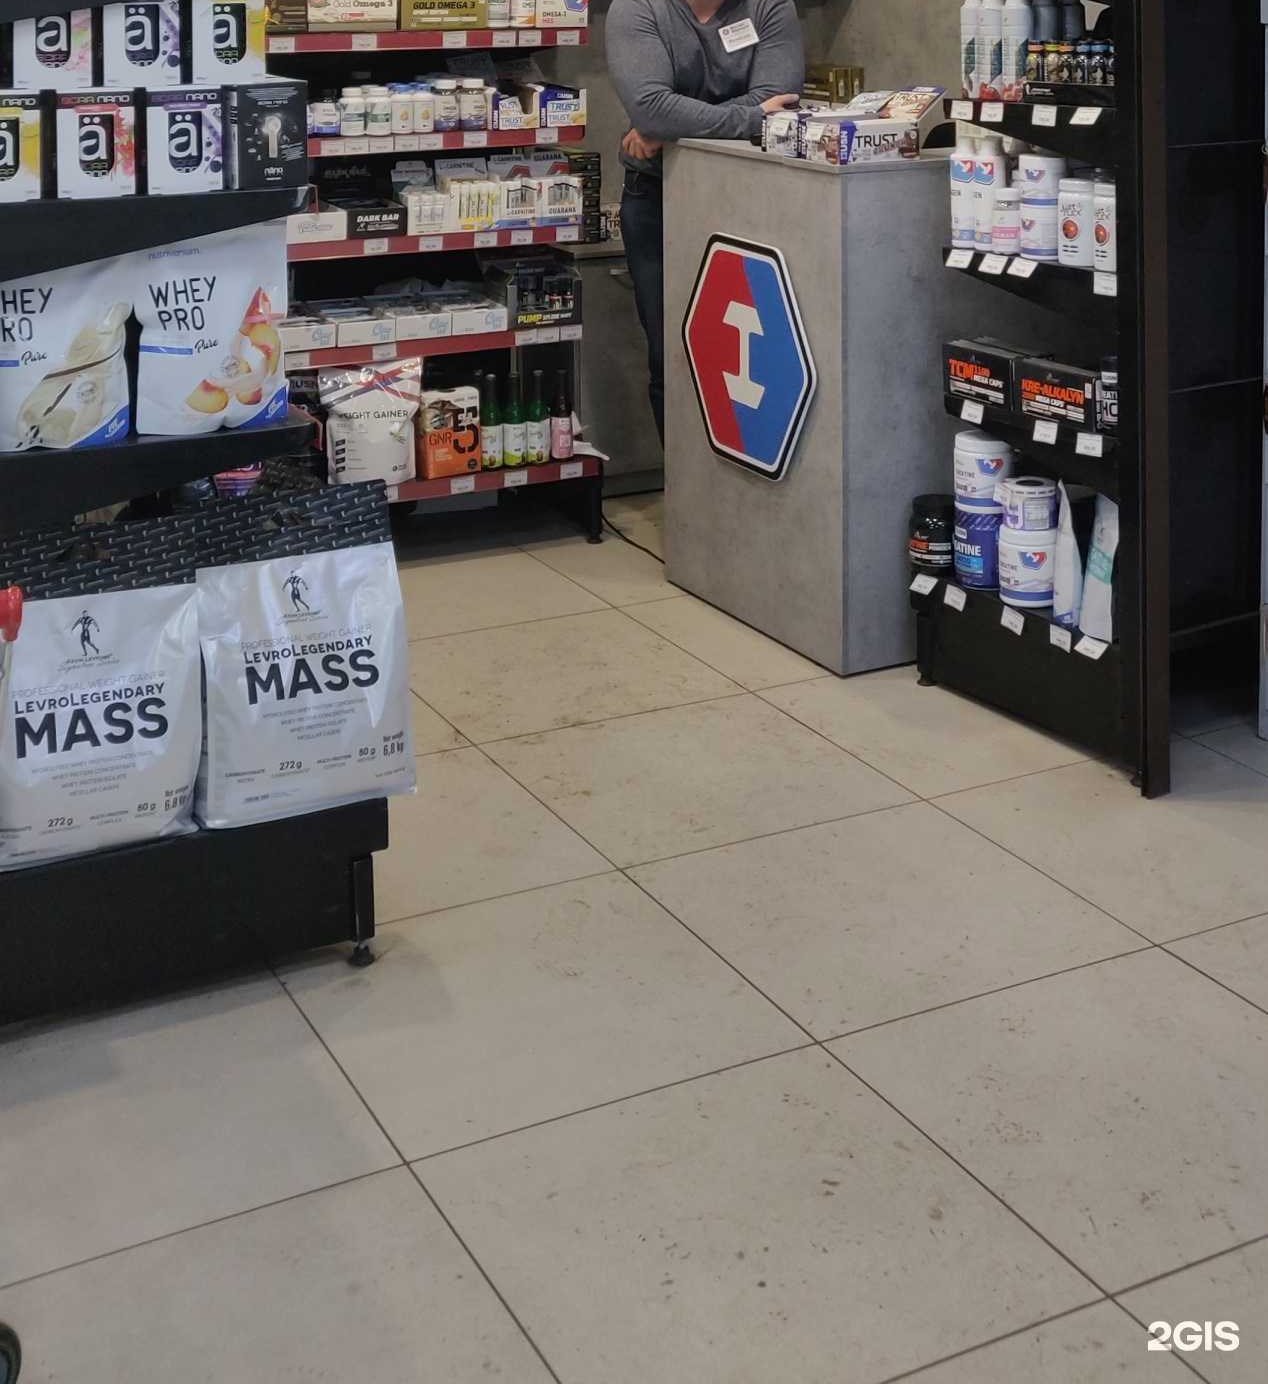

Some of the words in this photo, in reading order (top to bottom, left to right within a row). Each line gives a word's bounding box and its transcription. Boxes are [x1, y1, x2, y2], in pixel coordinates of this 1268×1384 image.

[332, 0, 352, 9] Gold
[352, 0, 386, 10] Omega
[386, 0, 394, 8] 3
[412, 1, 435, 10] GOLD
[437, 1, 467, 10] OMEGA
[468, 1, 476, 9] 3
[855, 132, 898, 149] TRUST
[356, 214, 380, 223] DARK
[381, 213, 400, 222] BAR
[148, 275, 217, 309] WHEY
[1, 287, 53, 315] HEY
[157, 305, 206, 332] PRO
[517, 314, 543, 324] PUMP
[2, 316, 34, 343] RO
[341, 410, 372, 420] EIGHT
[373, 409, 409, 419] GAINER
[428, 431, 452, 446] GNR
[245, 649, 380, 705] MASS
[15, 697, 169, 760] MASS
[47, 817, 66, 828] 272
